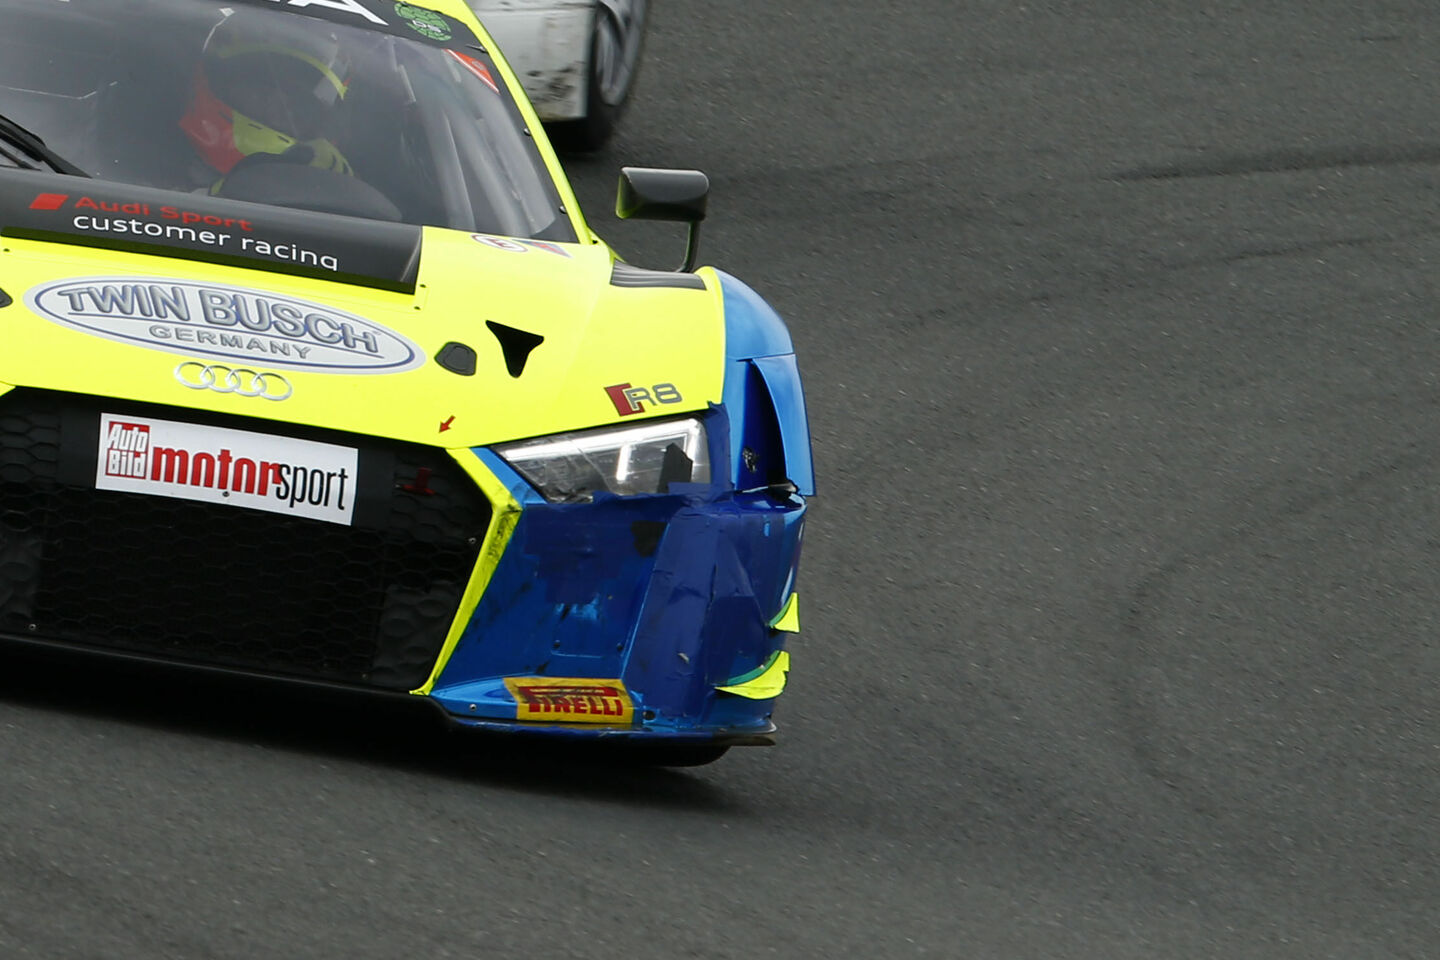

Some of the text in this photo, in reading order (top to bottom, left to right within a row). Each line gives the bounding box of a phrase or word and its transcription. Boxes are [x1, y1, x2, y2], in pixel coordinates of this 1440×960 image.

[74, 196, 254, 231] Audi Sport
[73, 215, 231, 247] customer
[57, 284, 381, 354] TWIN BUSCH
[149, 324, 311, 359] GERMANY
[623, 383, 683, 411] R8
[109, 422, 149, 452] Auto
[107, 450, 147, 478] Bild
[518, 686, 624, 716] PIRELLI
